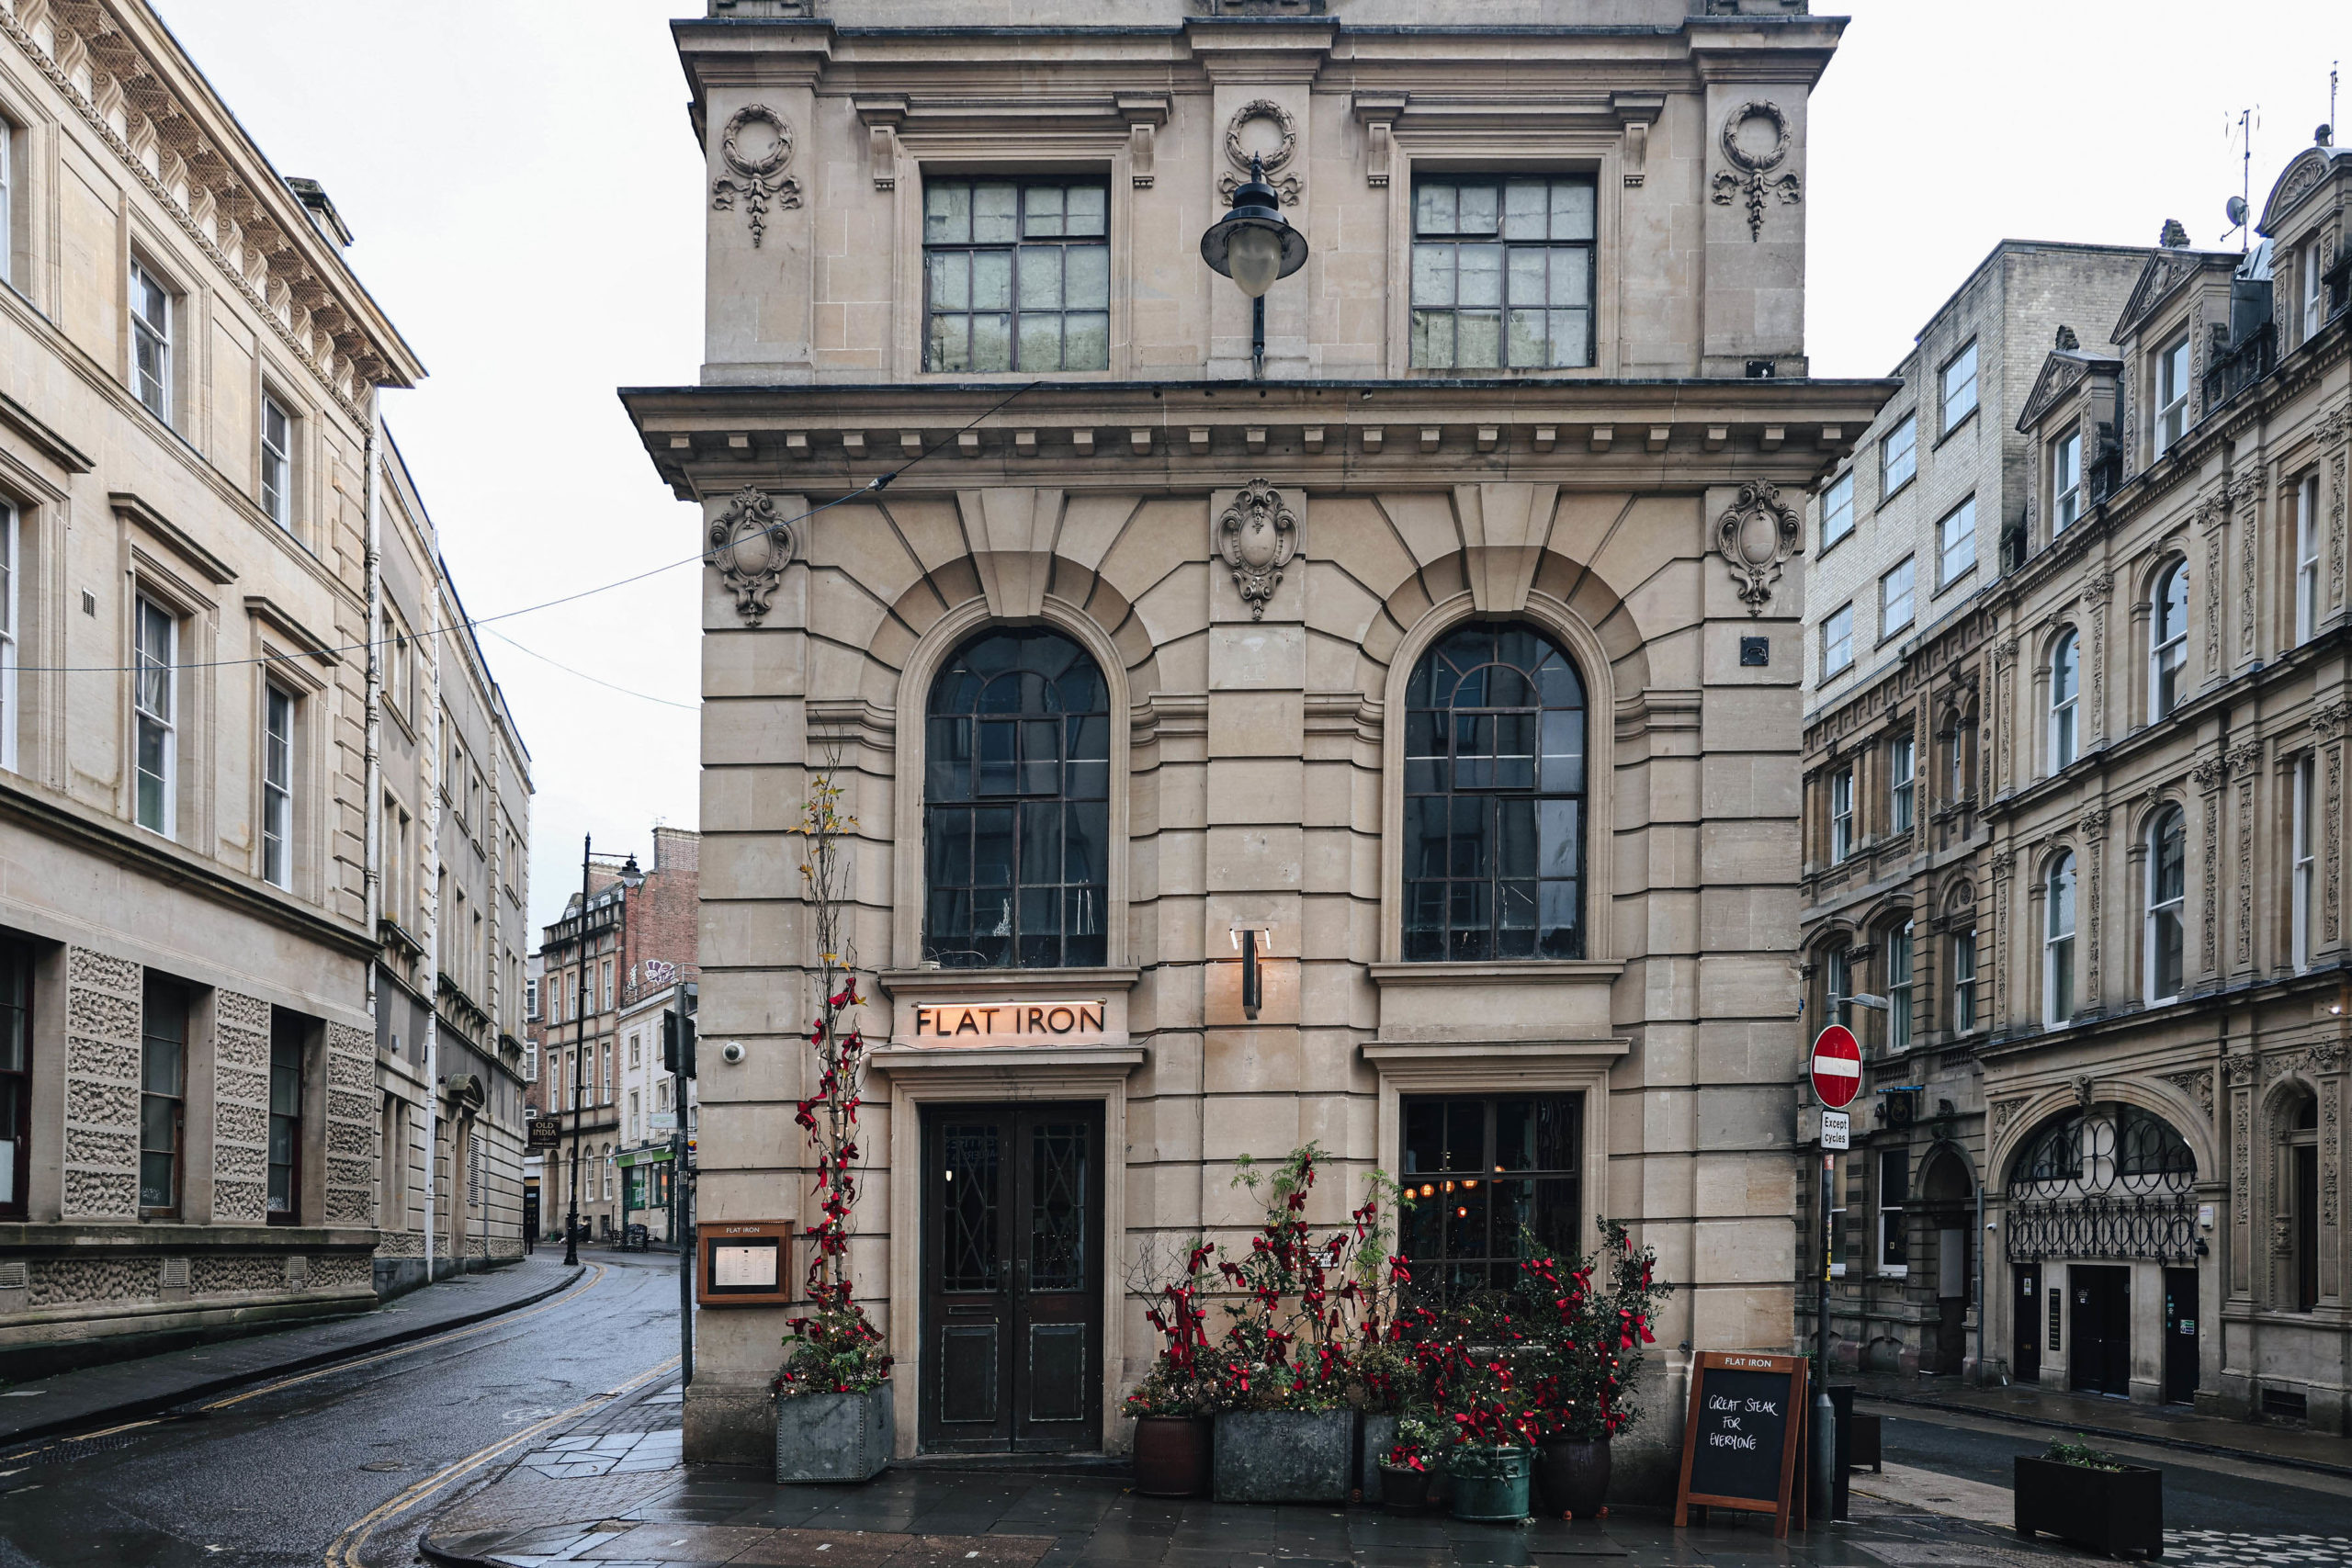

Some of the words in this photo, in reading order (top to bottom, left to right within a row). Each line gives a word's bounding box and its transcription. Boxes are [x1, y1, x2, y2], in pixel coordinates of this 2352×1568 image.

[917, 1008, 1000, 1036] FLAT
[1016, 1006, 1104, 1034] IRON
[1825, 1116, 1847, 1131] Except
[1825, 1132, 1846, 1144] cycles
[1724, 1357, 1746, 1366] FLAT
[1748, 1359, 1771, 1368] IRON
[1709, 1394, 1742, 1412] GREAT
[1745, 1397, 1779, 1416] STEAK
[1723, 1416, 1742, 1431] FOR
[1710, 1432, 1757, 1450] EVERYONE
